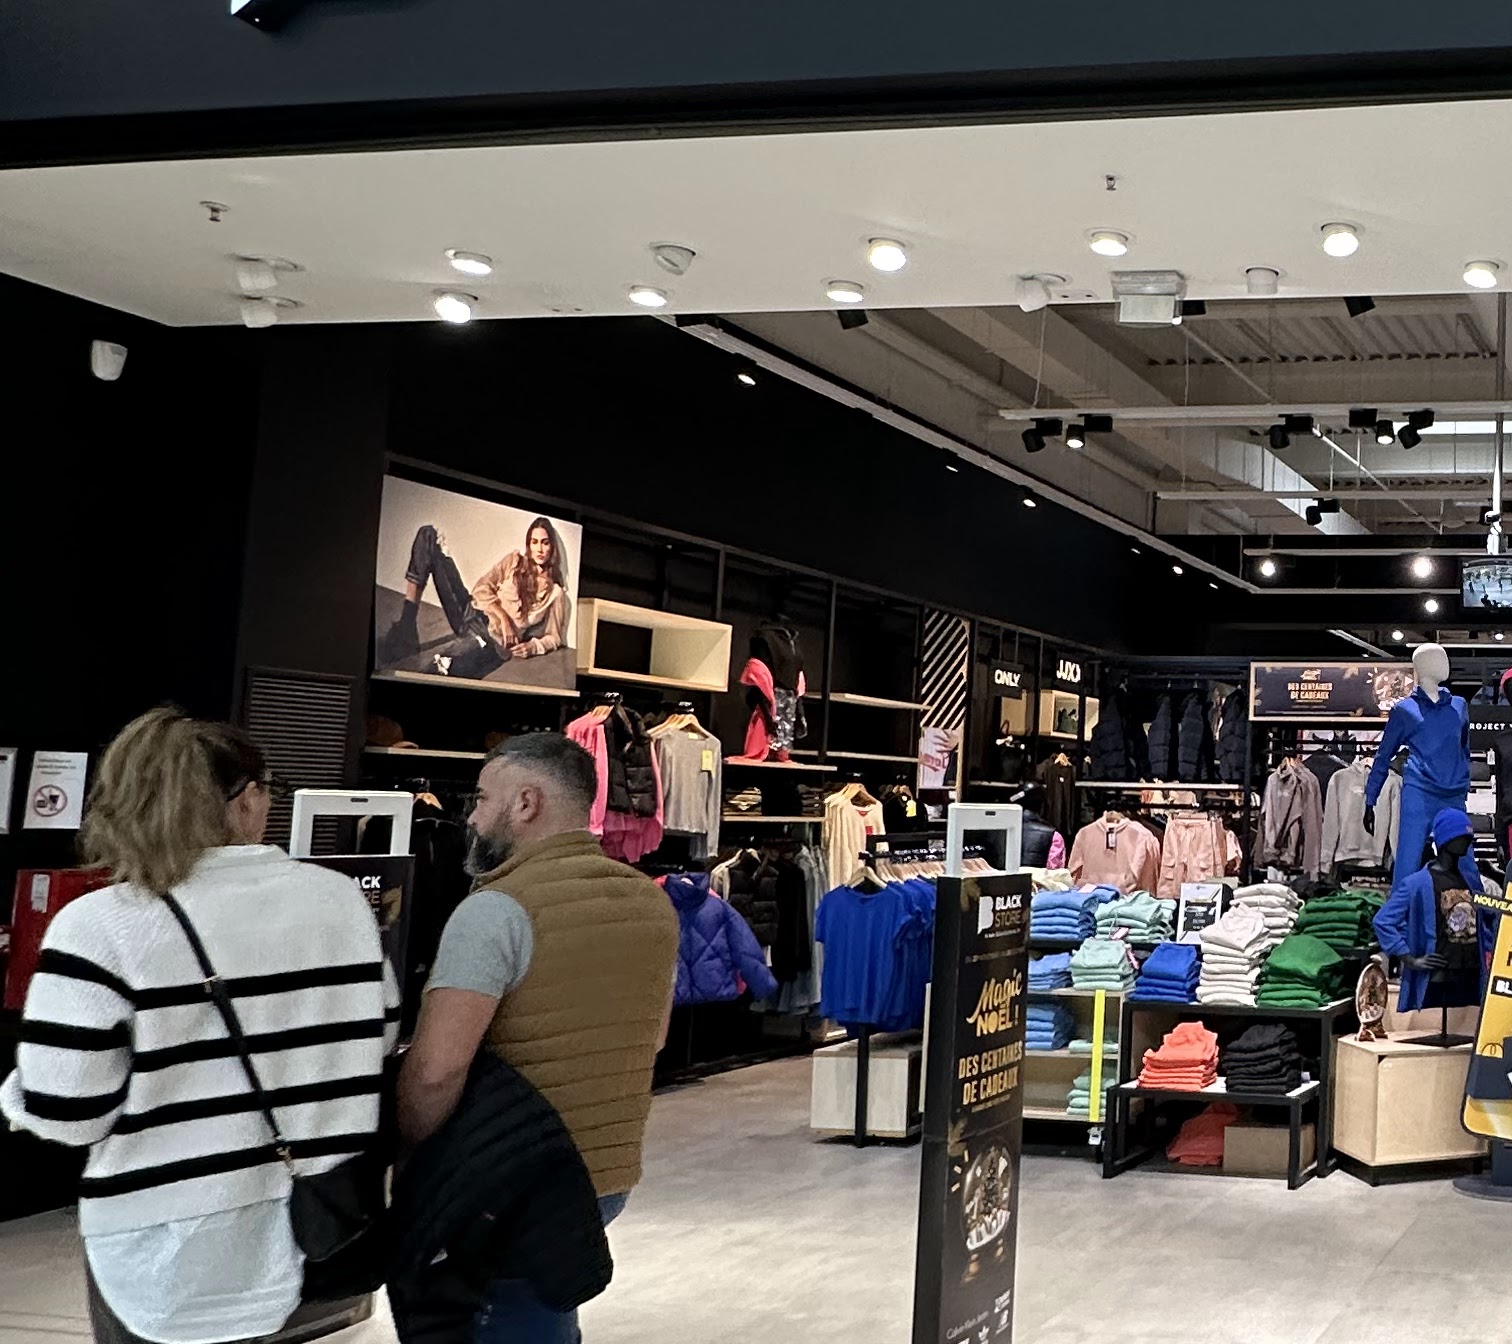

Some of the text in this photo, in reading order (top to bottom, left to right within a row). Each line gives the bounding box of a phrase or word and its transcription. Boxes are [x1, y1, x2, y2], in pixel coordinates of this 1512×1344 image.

[995, 669, 1021, 687] ONLY
[995, 894, 1022, 910] BLACK
[966, 968, 1023, 1023] Magic
[958, 1054, 979, 1079] DES
[962, 1080, 977, 1105] DE
[979, 1065, 1019, 1100] CADEAUX
